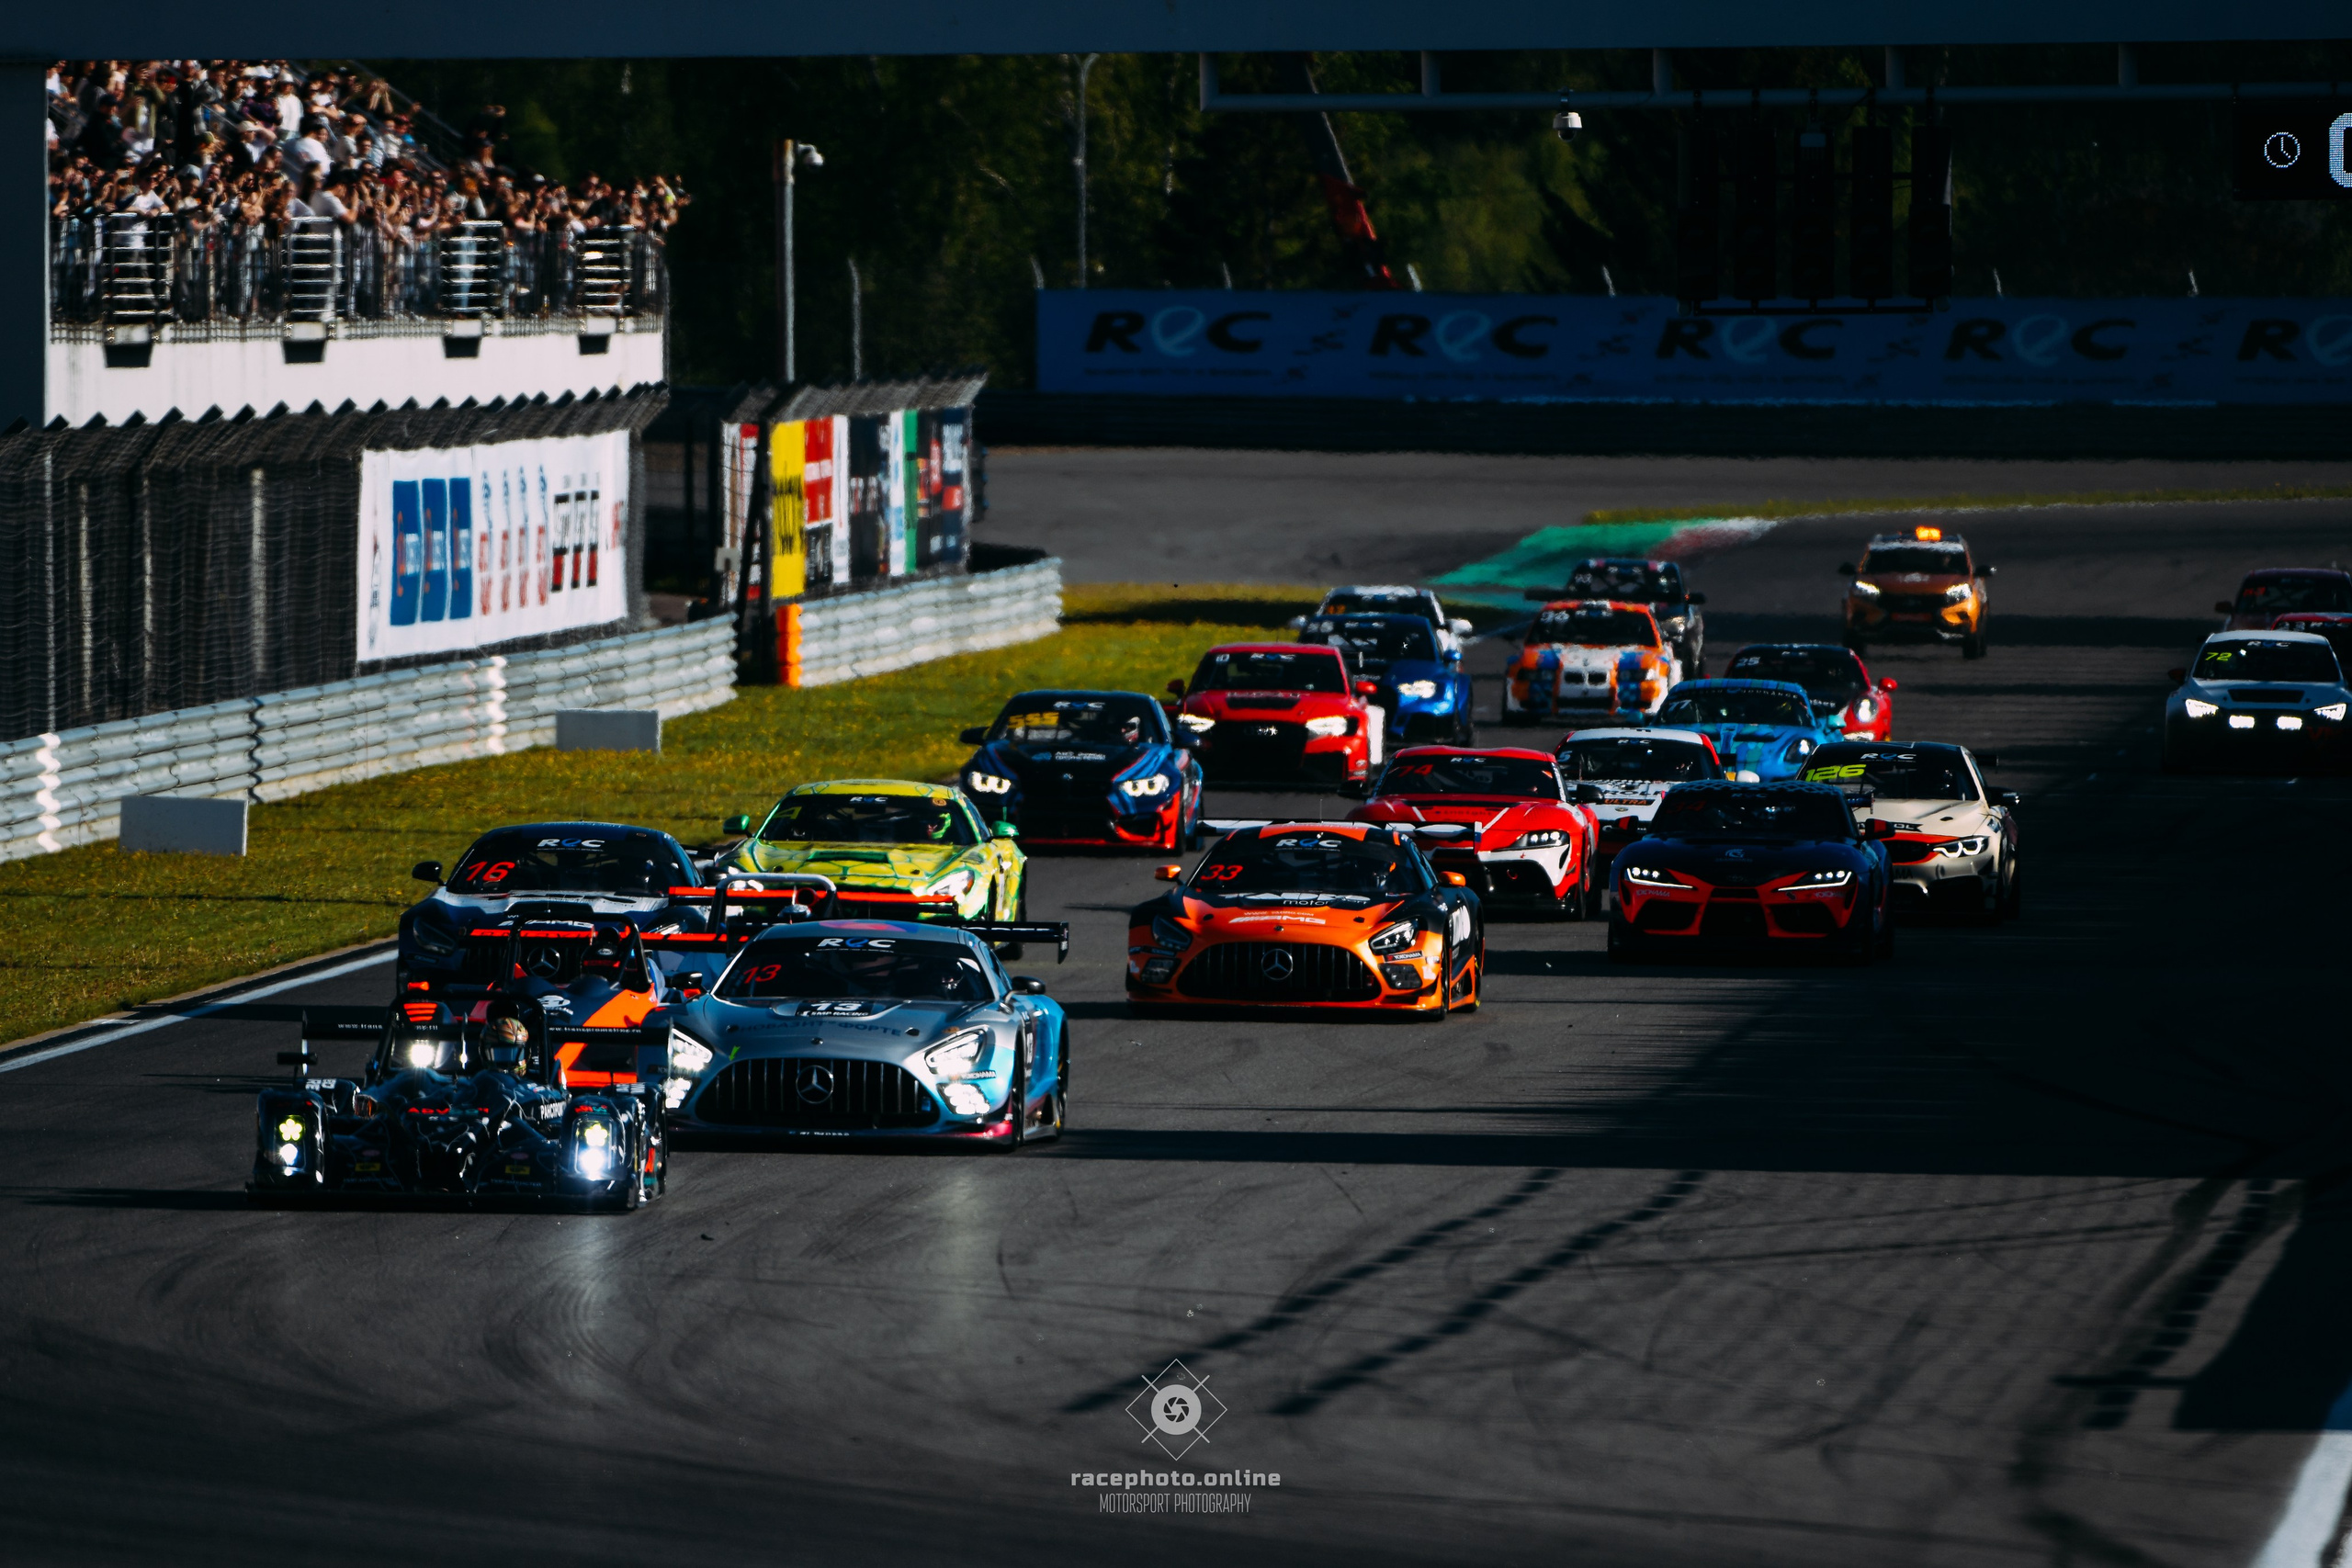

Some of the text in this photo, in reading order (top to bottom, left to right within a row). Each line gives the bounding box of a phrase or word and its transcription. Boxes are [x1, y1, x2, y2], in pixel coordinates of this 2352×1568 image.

[2205, 651, 2233, 662] 72
[1804, 763, 1868, 783] 126
[465, 861, 516, 883] 16
[1200, 863, 1245, 882] 33
[742, 964, 782, 985] 13
[810, 1002, 862, 1011] 13
[838, 1021, 902, 1037] ФОРТЕ
